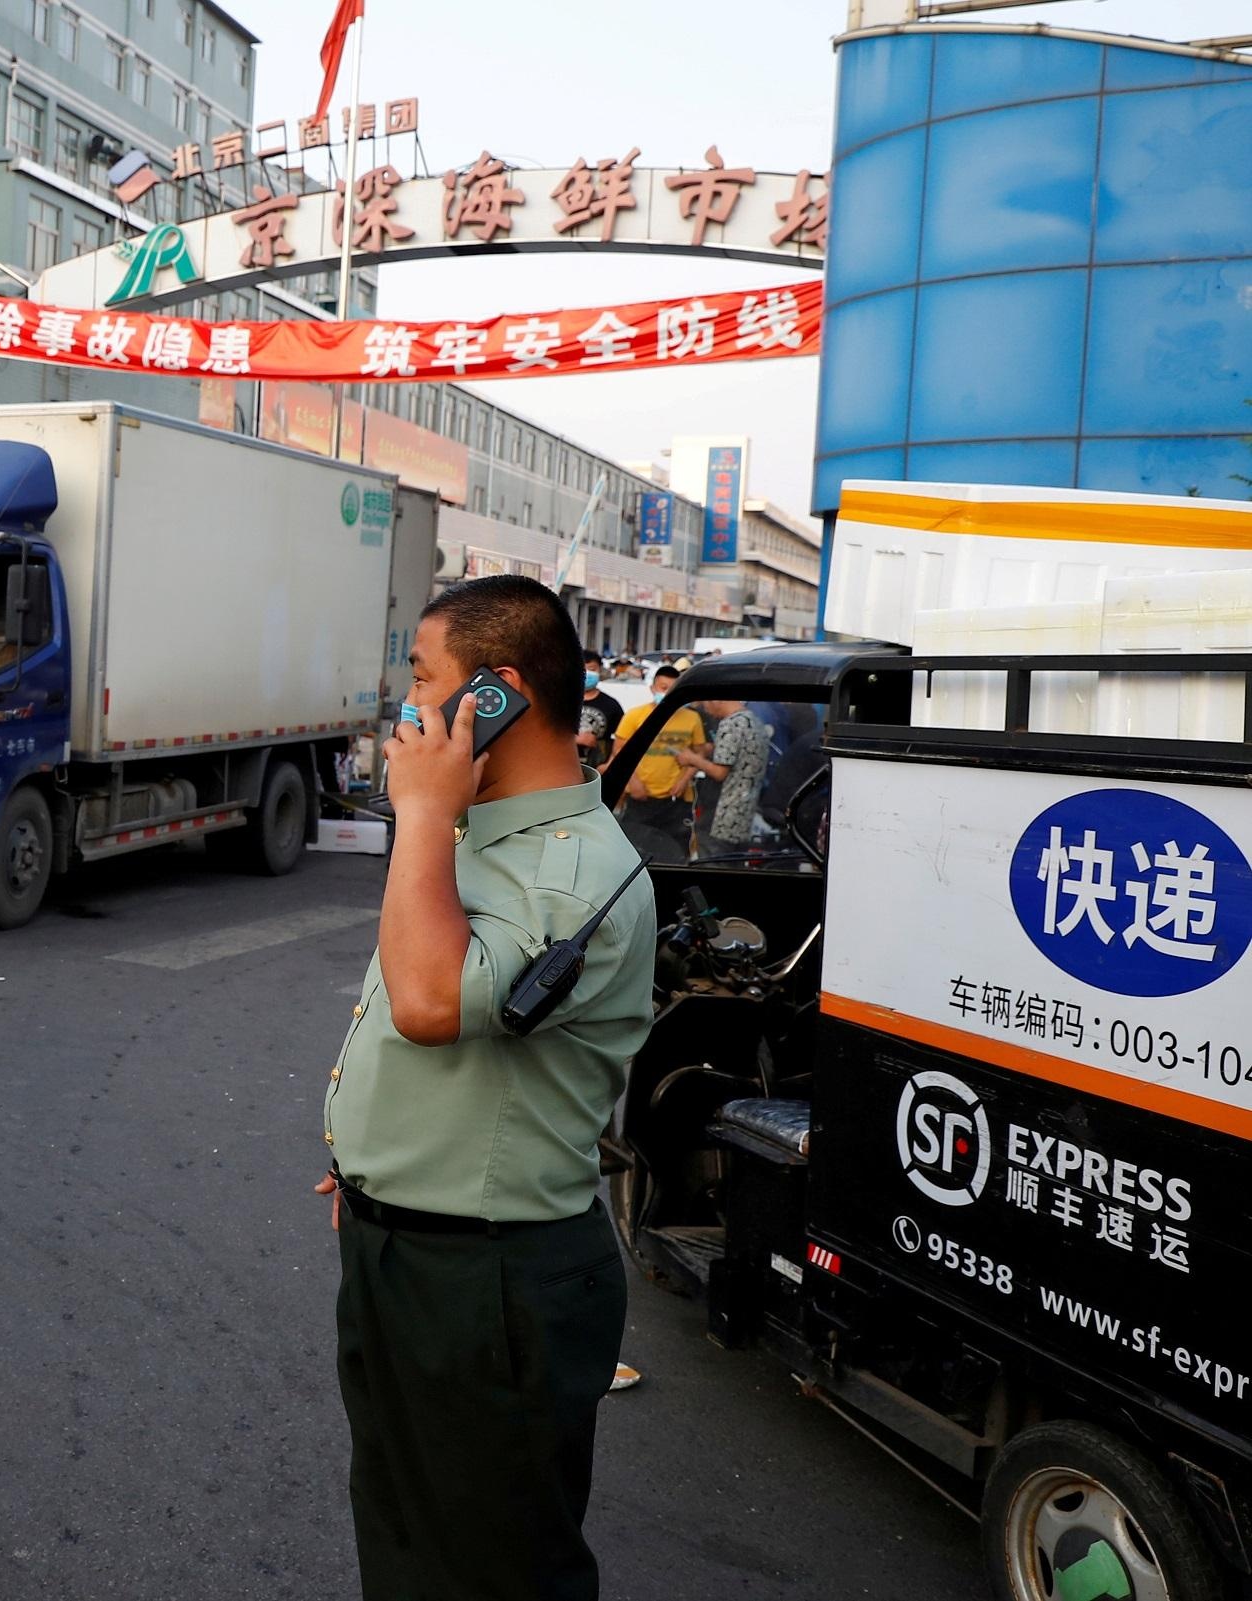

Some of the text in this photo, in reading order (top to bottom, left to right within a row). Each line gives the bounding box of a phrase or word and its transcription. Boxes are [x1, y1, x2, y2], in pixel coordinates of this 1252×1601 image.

[172, 98, 418, 181] 北京二商集团
[360, 291, 804, 377] 筑牢安全防线
[1037, 825, 1217, 962] 快递
[1005, 1166, 1191, 1274] 顺丰速运
[1007, 1122, 1192, 1221] EXPRESS
[927, 1232, 1250, 1400] 95338 www.sf-expr
